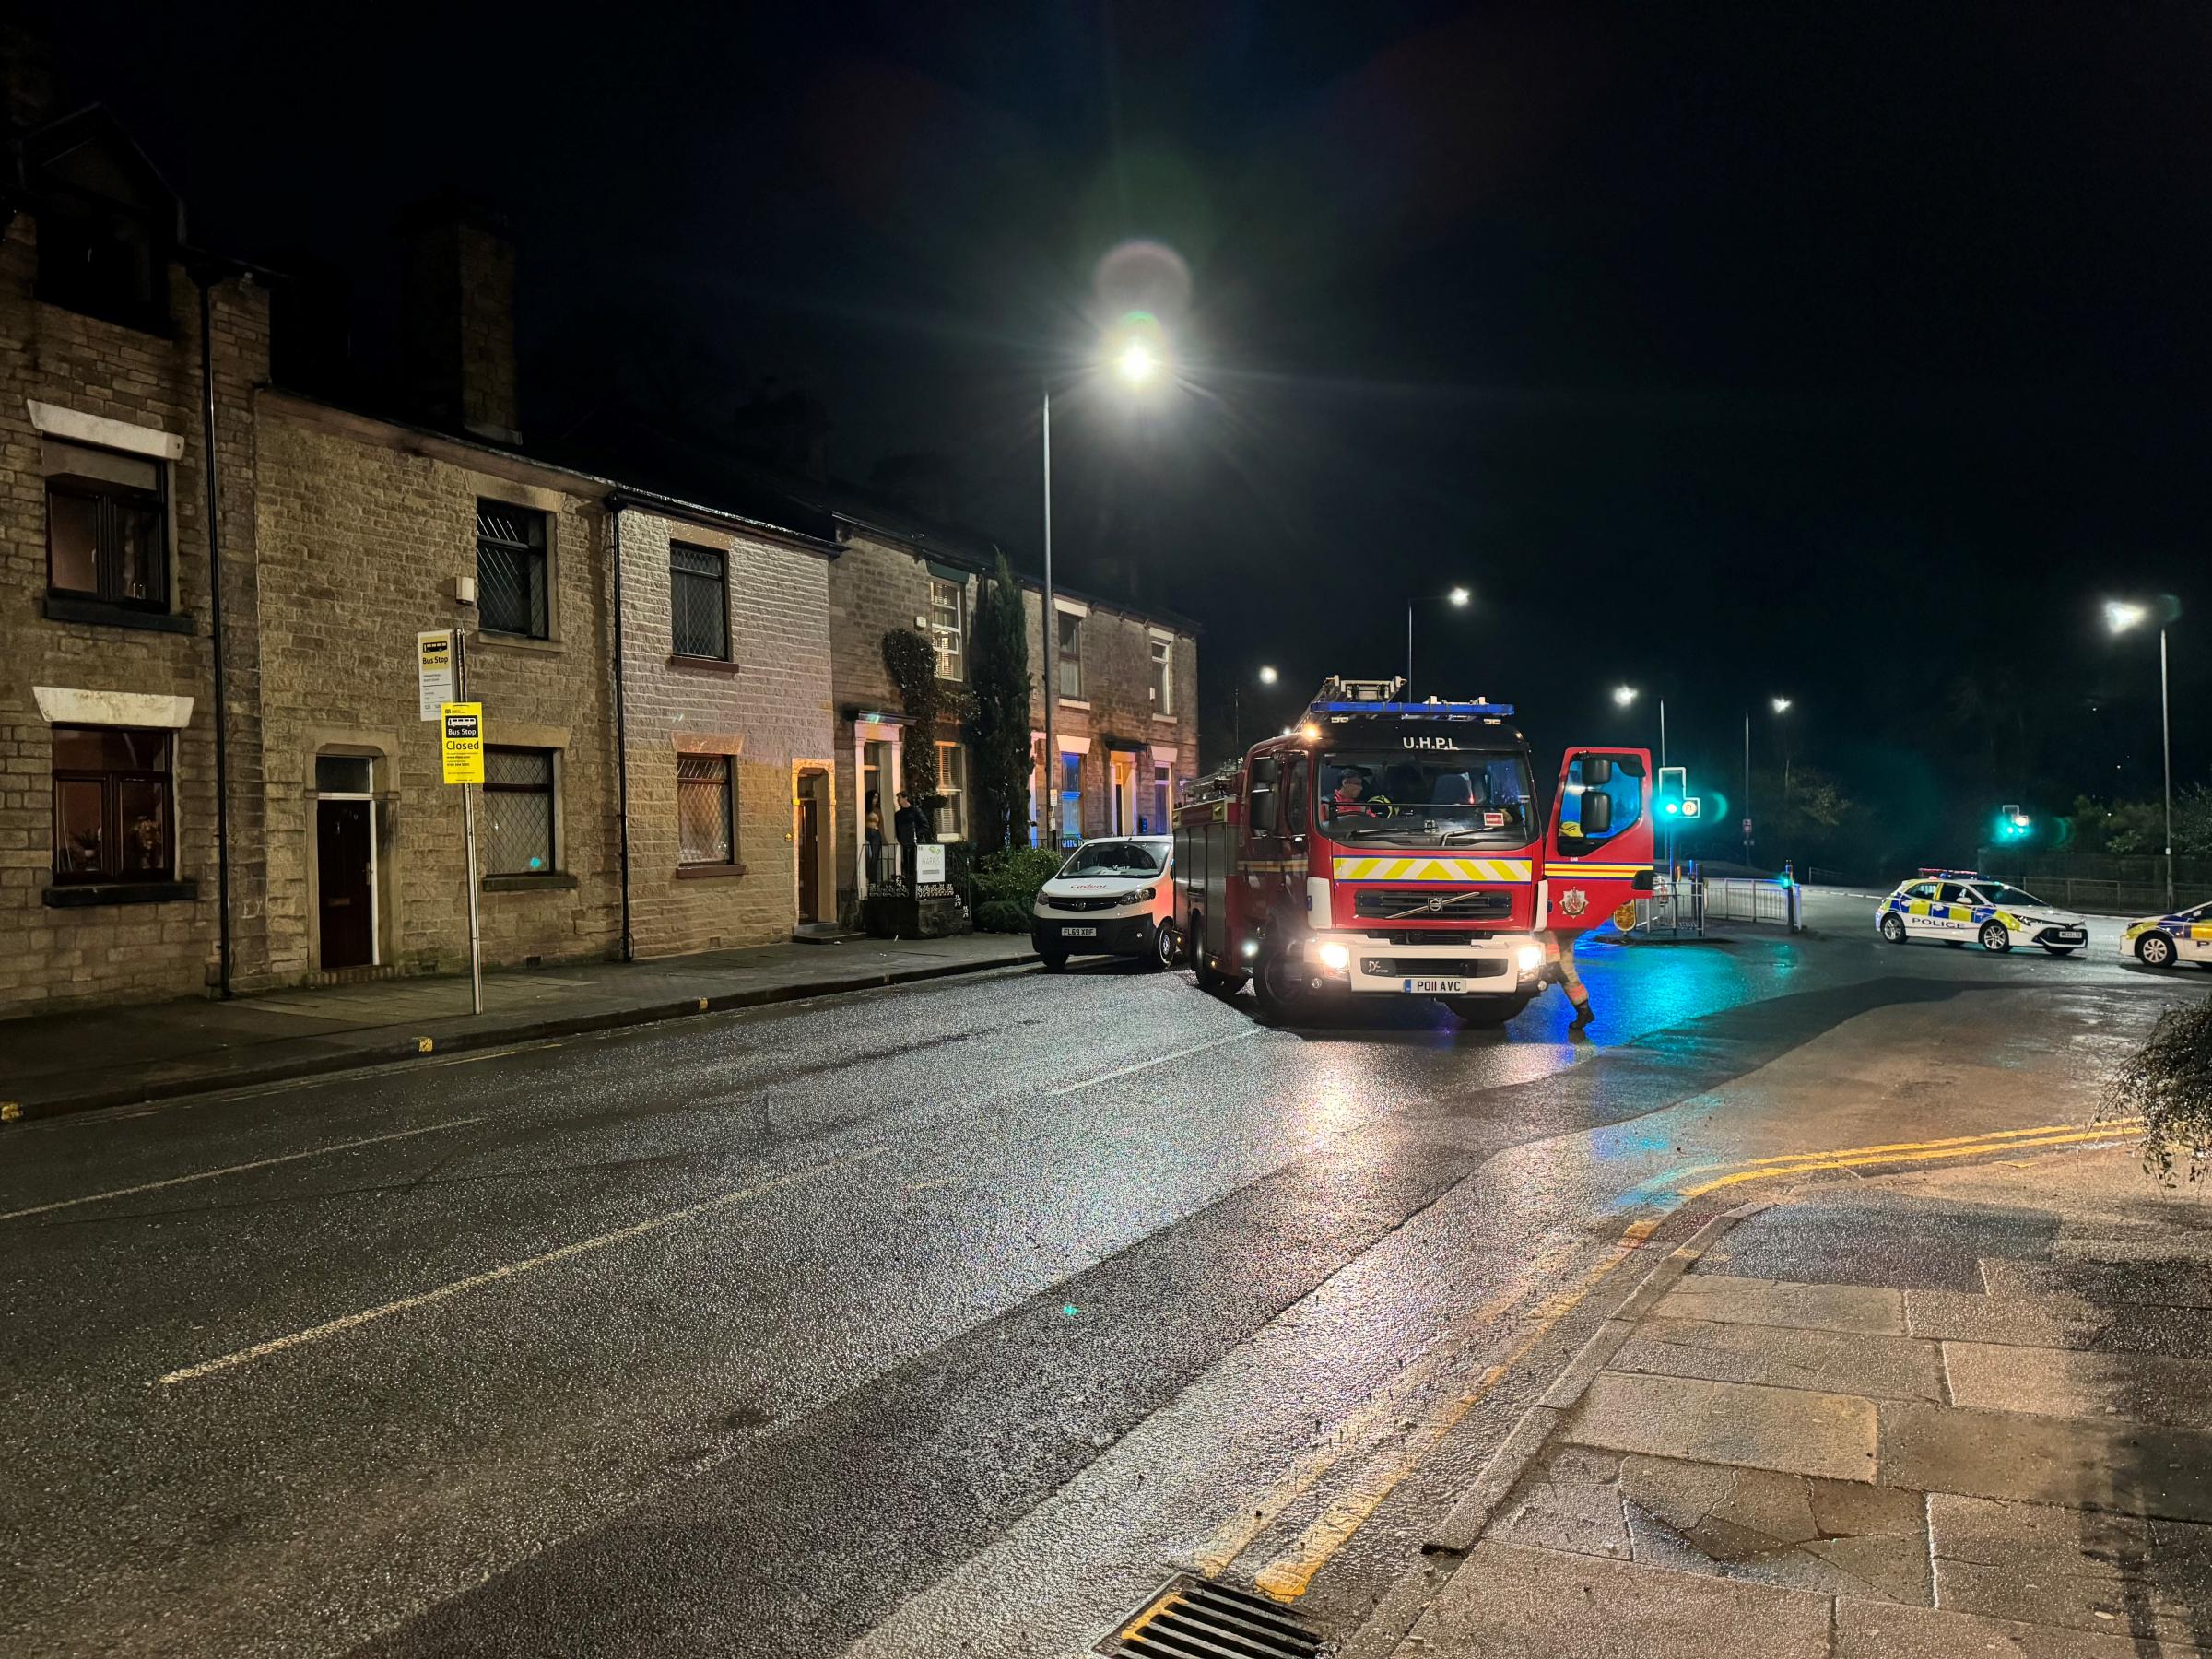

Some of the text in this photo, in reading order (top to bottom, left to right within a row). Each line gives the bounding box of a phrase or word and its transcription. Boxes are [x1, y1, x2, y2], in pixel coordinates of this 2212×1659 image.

[434, 655, 449, 665] Stop
[461, 728, 477, 736] Stop
[446, 740, 479, 750] Closed
[1912, 917, 1965, 929] POLICE
[1440, 980, 1462, 992] AVC
